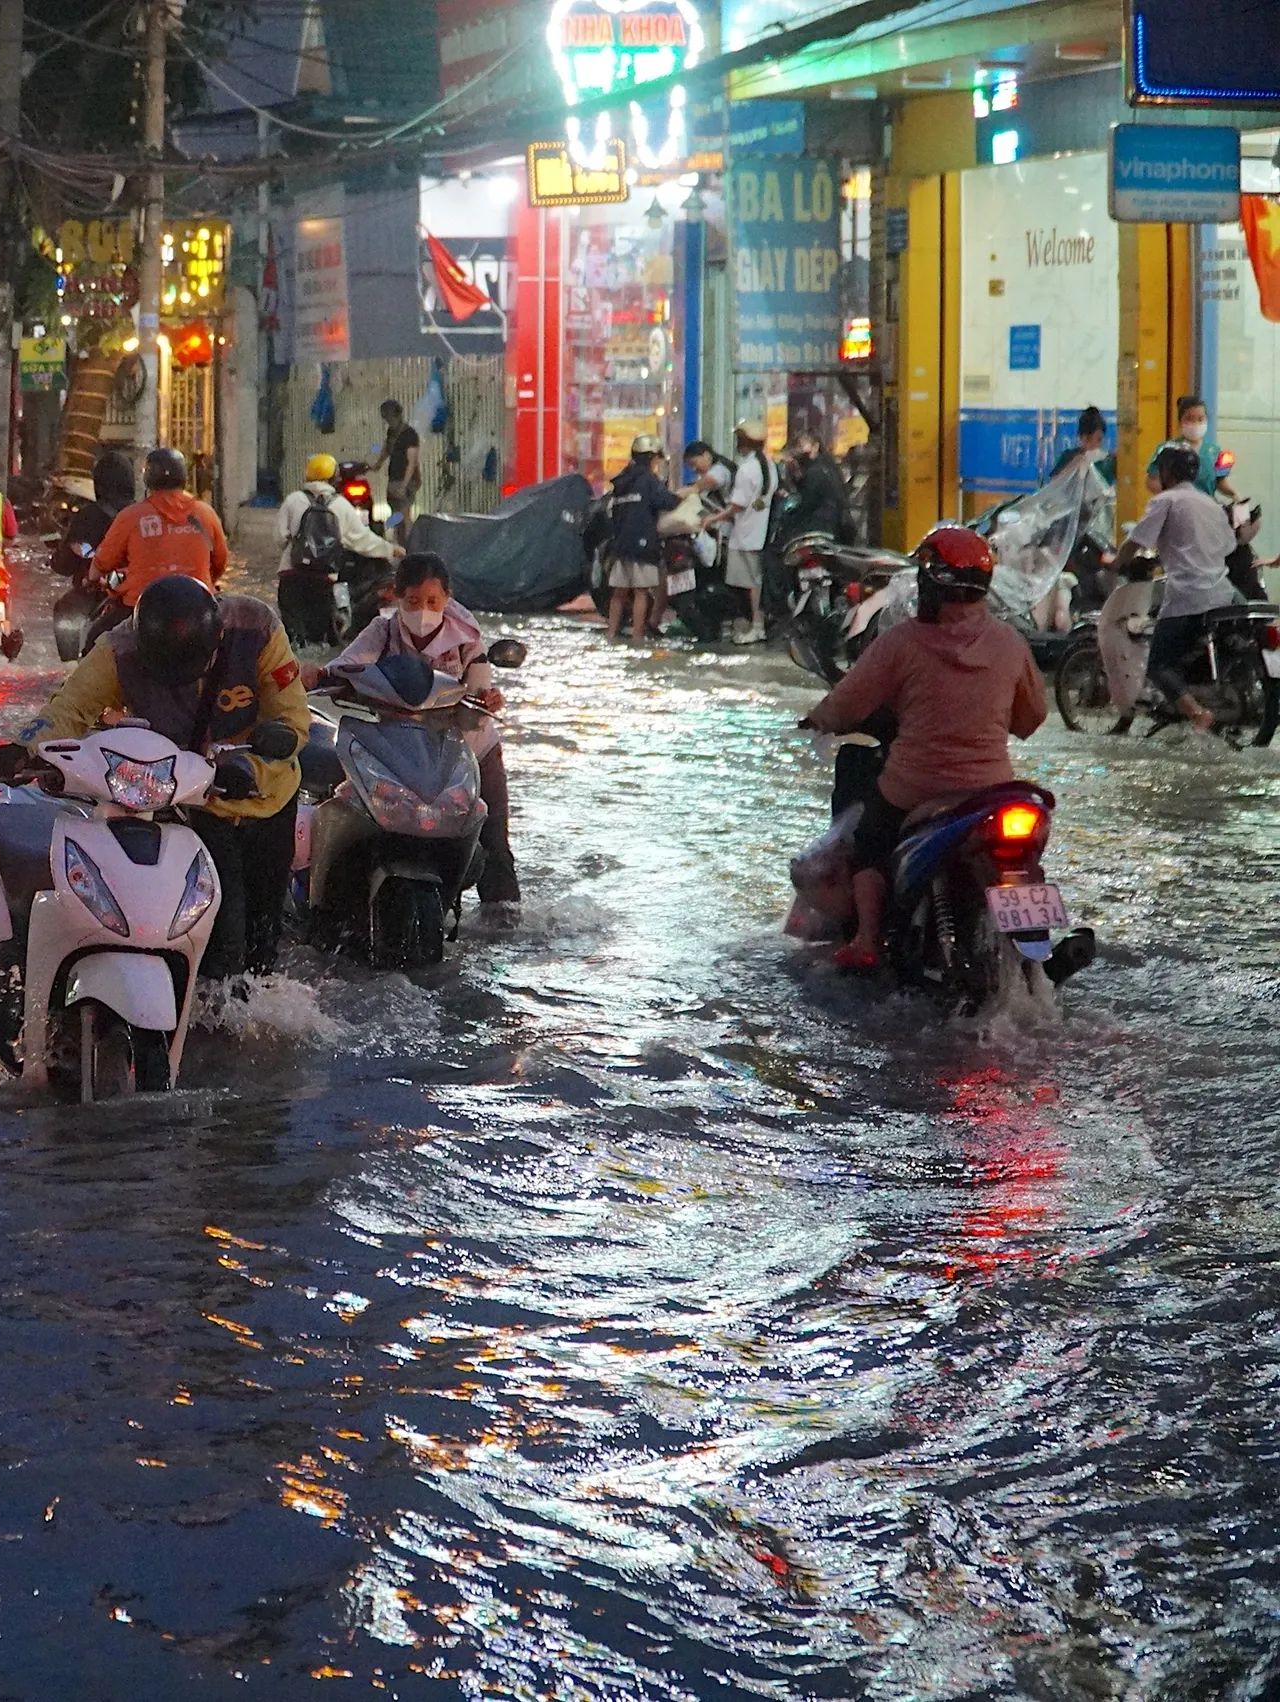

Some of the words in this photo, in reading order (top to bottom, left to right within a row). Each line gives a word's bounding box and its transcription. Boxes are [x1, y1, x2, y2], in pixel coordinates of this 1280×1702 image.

[563, 14, 614, 45] NHA
[620, 13, 686, 45] KHOA
[738, 172, 784, 222] BA
[793, 162, 834, 222] LÔ
[1026, 227, 1095, 268] Welcome
[736, 240, 787, 293] GIÀY
[794, 241, 838, 293] DÉP
[998, 888, 1051, 907] 59-C2
[998, 907, 1063, 928] 981.34
